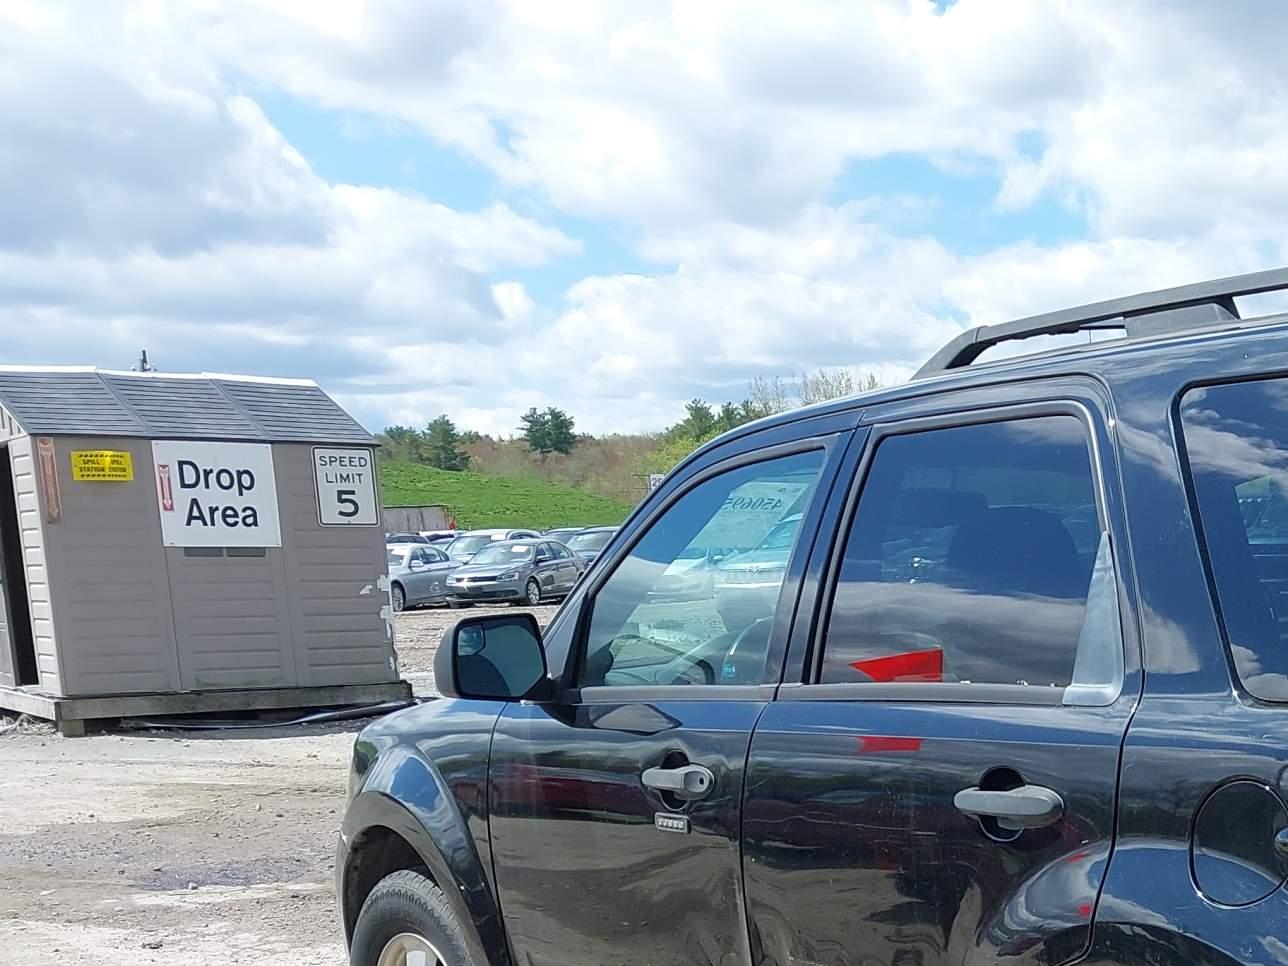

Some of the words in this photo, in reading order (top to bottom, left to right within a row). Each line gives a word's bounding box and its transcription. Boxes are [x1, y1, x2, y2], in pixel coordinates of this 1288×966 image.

[319, 455, 367, 468] SPEED
[177, 460, 256, 496] Drop
[325, 472, 364, 484] LIMIT
[185, 498, 259, 528] Area
[337, 490, 359, 518] 5
